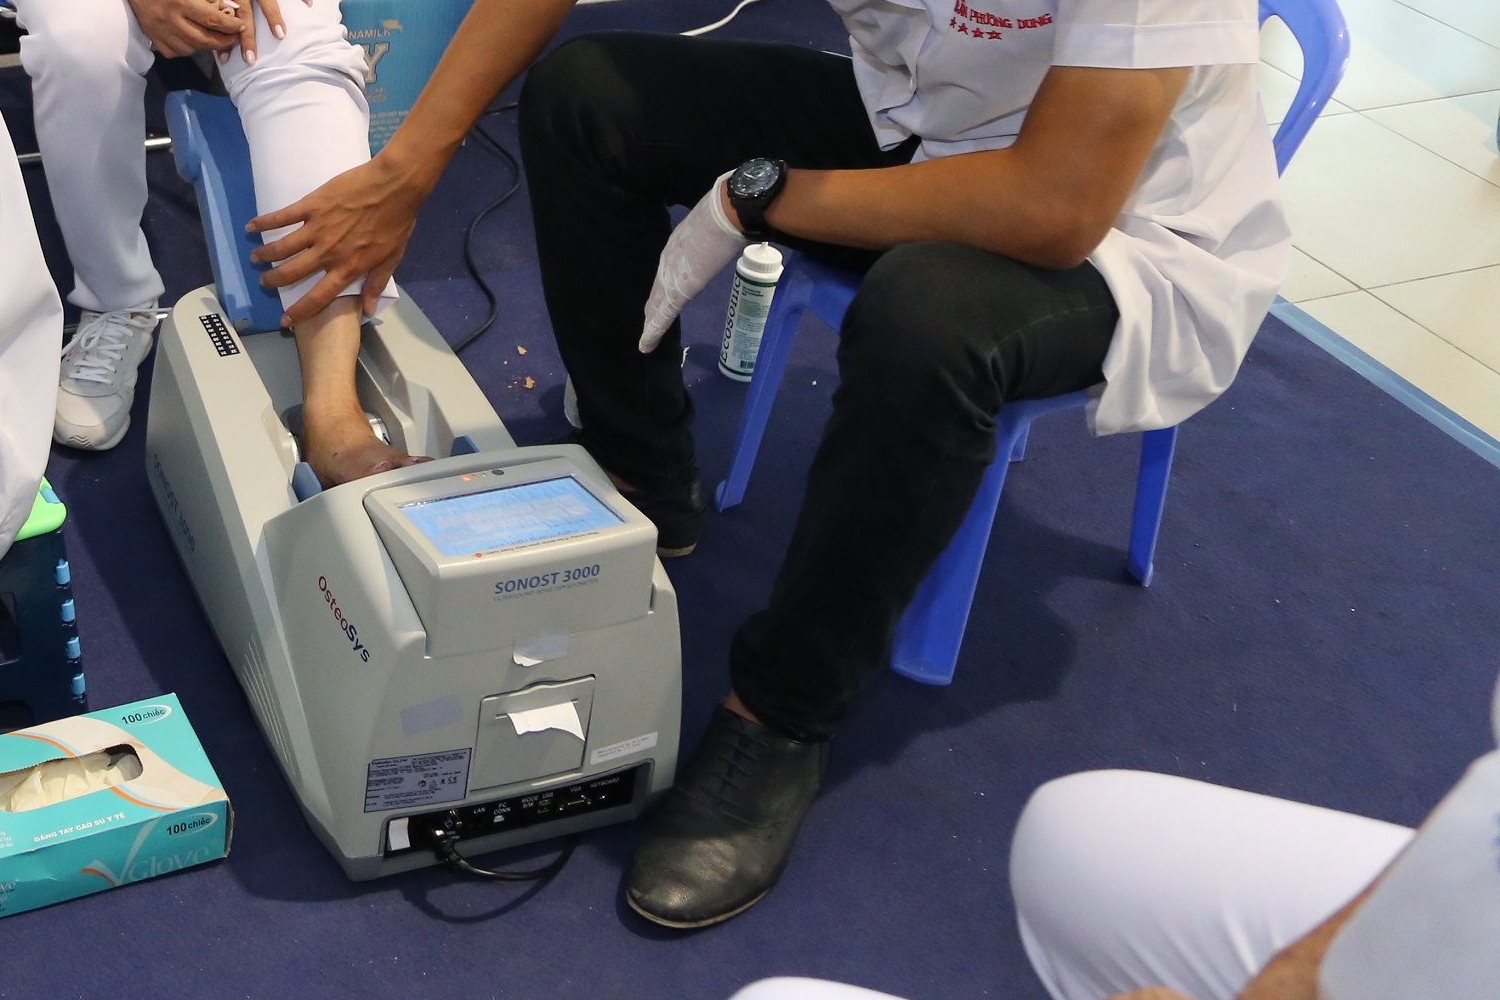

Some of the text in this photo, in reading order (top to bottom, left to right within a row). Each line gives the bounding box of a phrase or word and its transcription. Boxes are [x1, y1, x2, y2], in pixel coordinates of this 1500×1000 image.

[348, 27, 392, 40] NAMILK
[720, 277, 741, 363] Ecosonic
[494, 564, 601, 595] SONOST 3000
[318, 576, 370, 663] OsteoSys
[121, 708, 166, 725] 100 chiếc
[570, 785, 582, 793] VGA
[493, 807, 512, 815] CONN
[58, 827, 74, 835] TAY
[75, 822, 93, 831] CAO
[94, 818, 105, 826] SU
[167, 815, 211, 836] 100 chiếc
